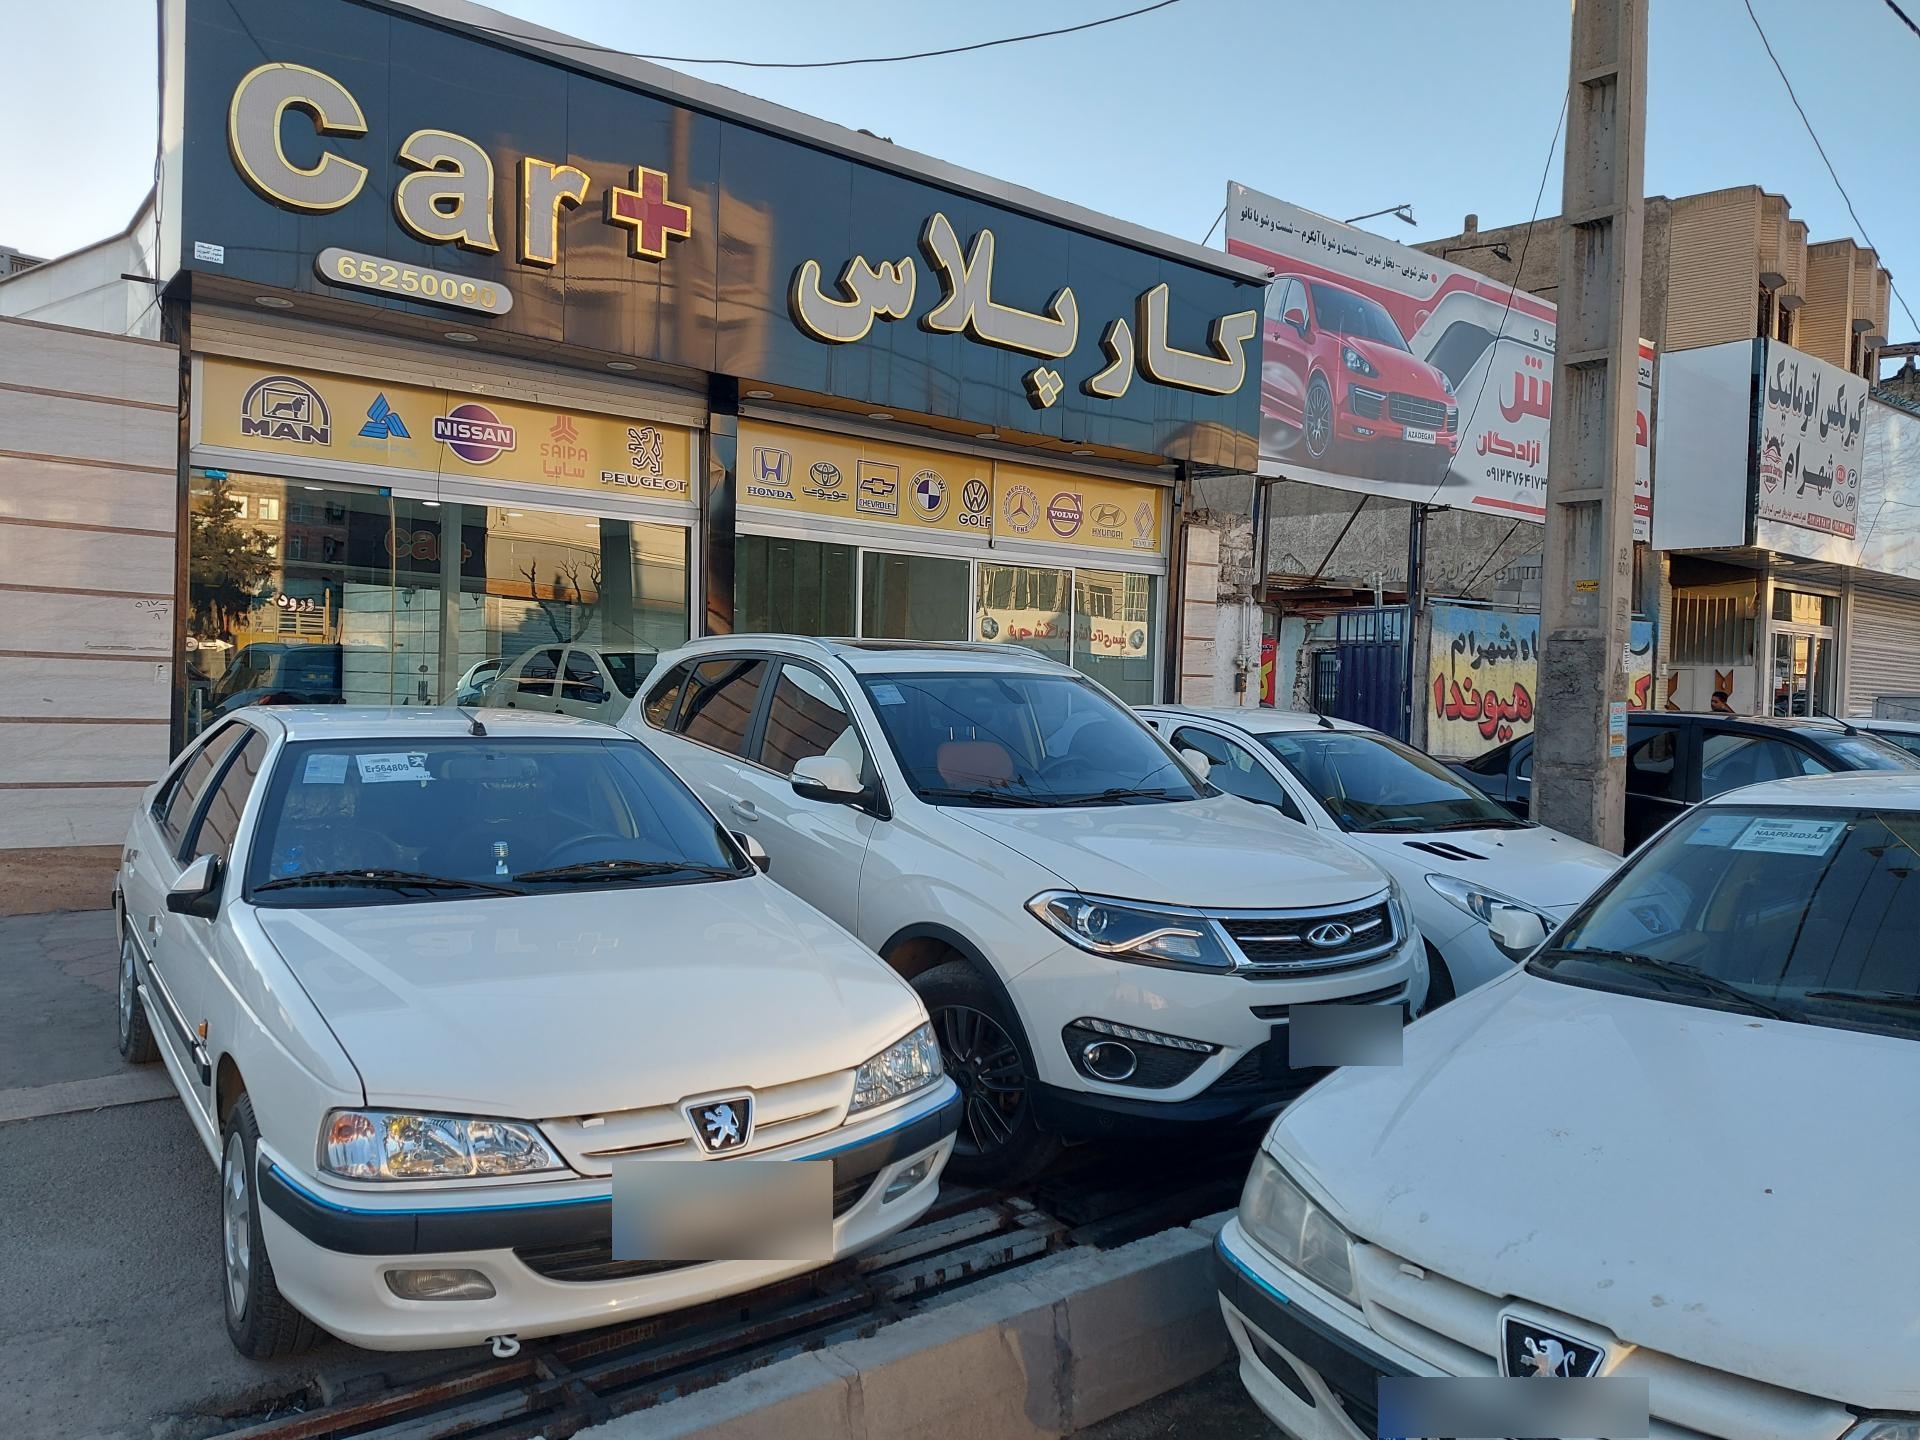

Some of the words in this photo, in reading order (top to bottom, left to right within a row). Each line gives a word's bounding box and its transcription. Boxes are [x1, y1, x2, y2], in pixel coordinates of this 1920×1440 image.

[1239, 205, 1253, 221] نانو
[1253, 209, 1259, 226] با
[1259, 213, 1270, 228] شو
[1269, 220, 1275, 232] و
[1275, 220, 1293, 234] شست
[1341, 243, 1358, 256] شست
[336, 256, 497, 309] 65250090
[241, 416, 330, 444] MAN
[436, 420, 511, 445] NISSAN
[540, 443, 588, 462] SAIPA
[1475, 430, 1541, 468] آزادگان
[543, 460, 585, 479] سایپا
[600, 471, 688, 493] PEUGEOT
[747, 486, 795, 500] HONDA
[858, 498, 896, 511] CHEVROLET
[959, 512, 992, 527] GOLF
[1051, 510, 1080, 520] VOLVO
[1091, 528, 1123, 540] HYUNDAI
[277, 593, 315, 612] ورود
[1451, 622, 1518, 681] شهرام
